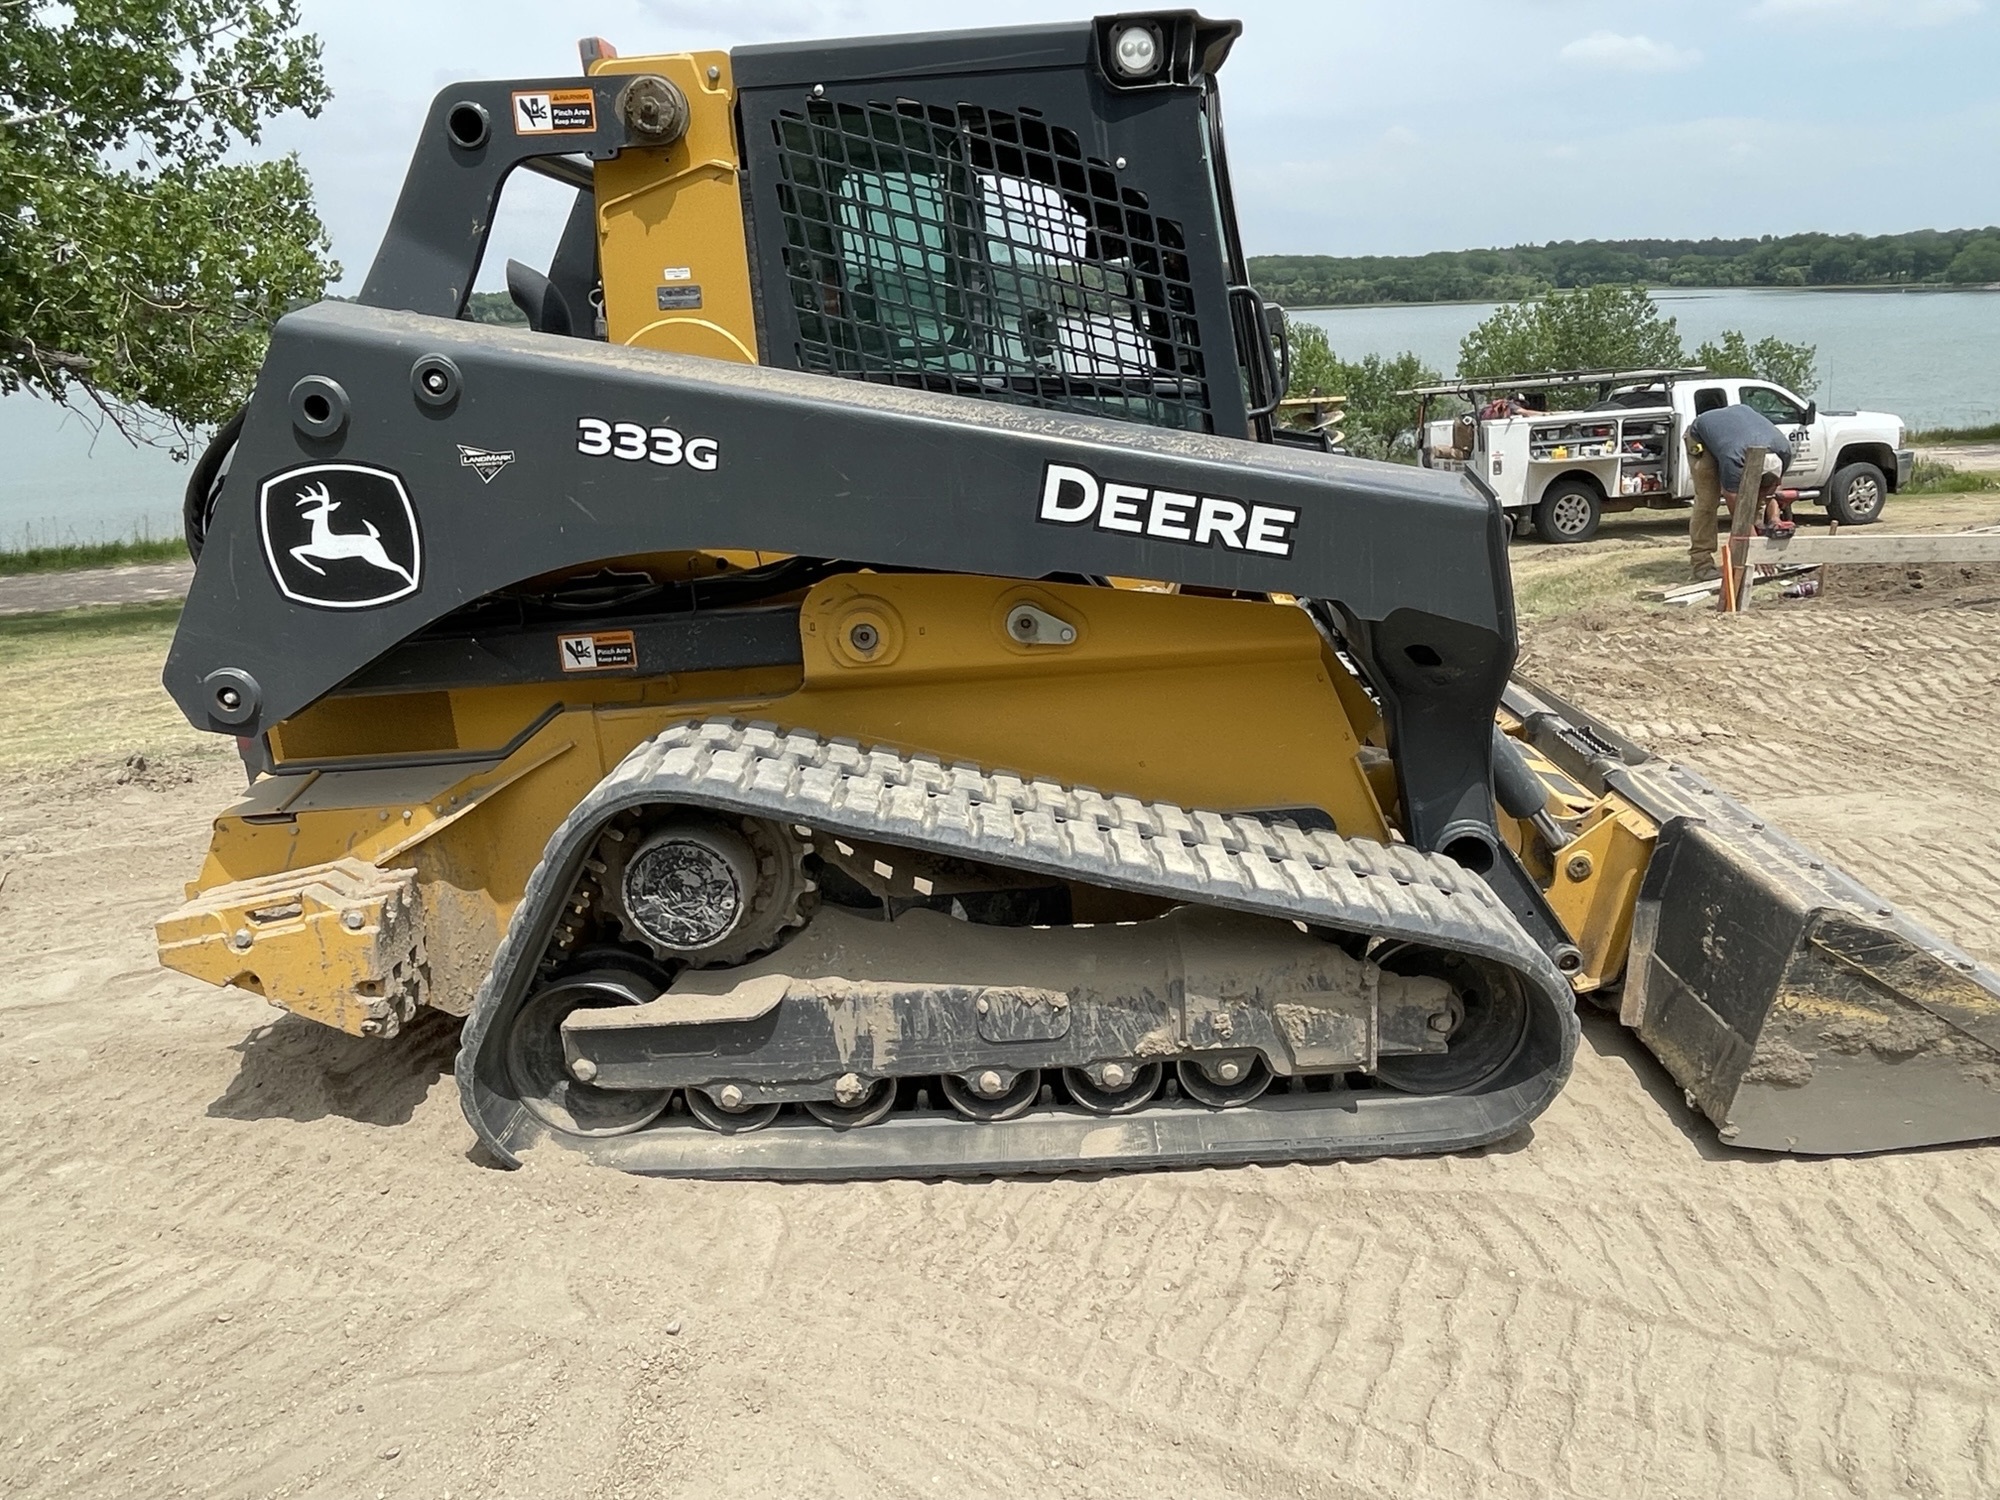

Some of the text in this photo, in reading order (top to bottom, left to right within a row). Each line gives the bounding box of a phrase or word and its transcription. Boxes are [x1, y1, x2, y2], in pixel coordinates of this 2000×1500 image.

[574, 108, 590, 116] Area
[1788, 429, 1810, 442] ent
[577, 417, 718, 471] 333G
[463, 454, 512, 463] LANDMARK
[1040, 463, 1297, 556] DEERE
[597, 648, 615, 656] Pinch
